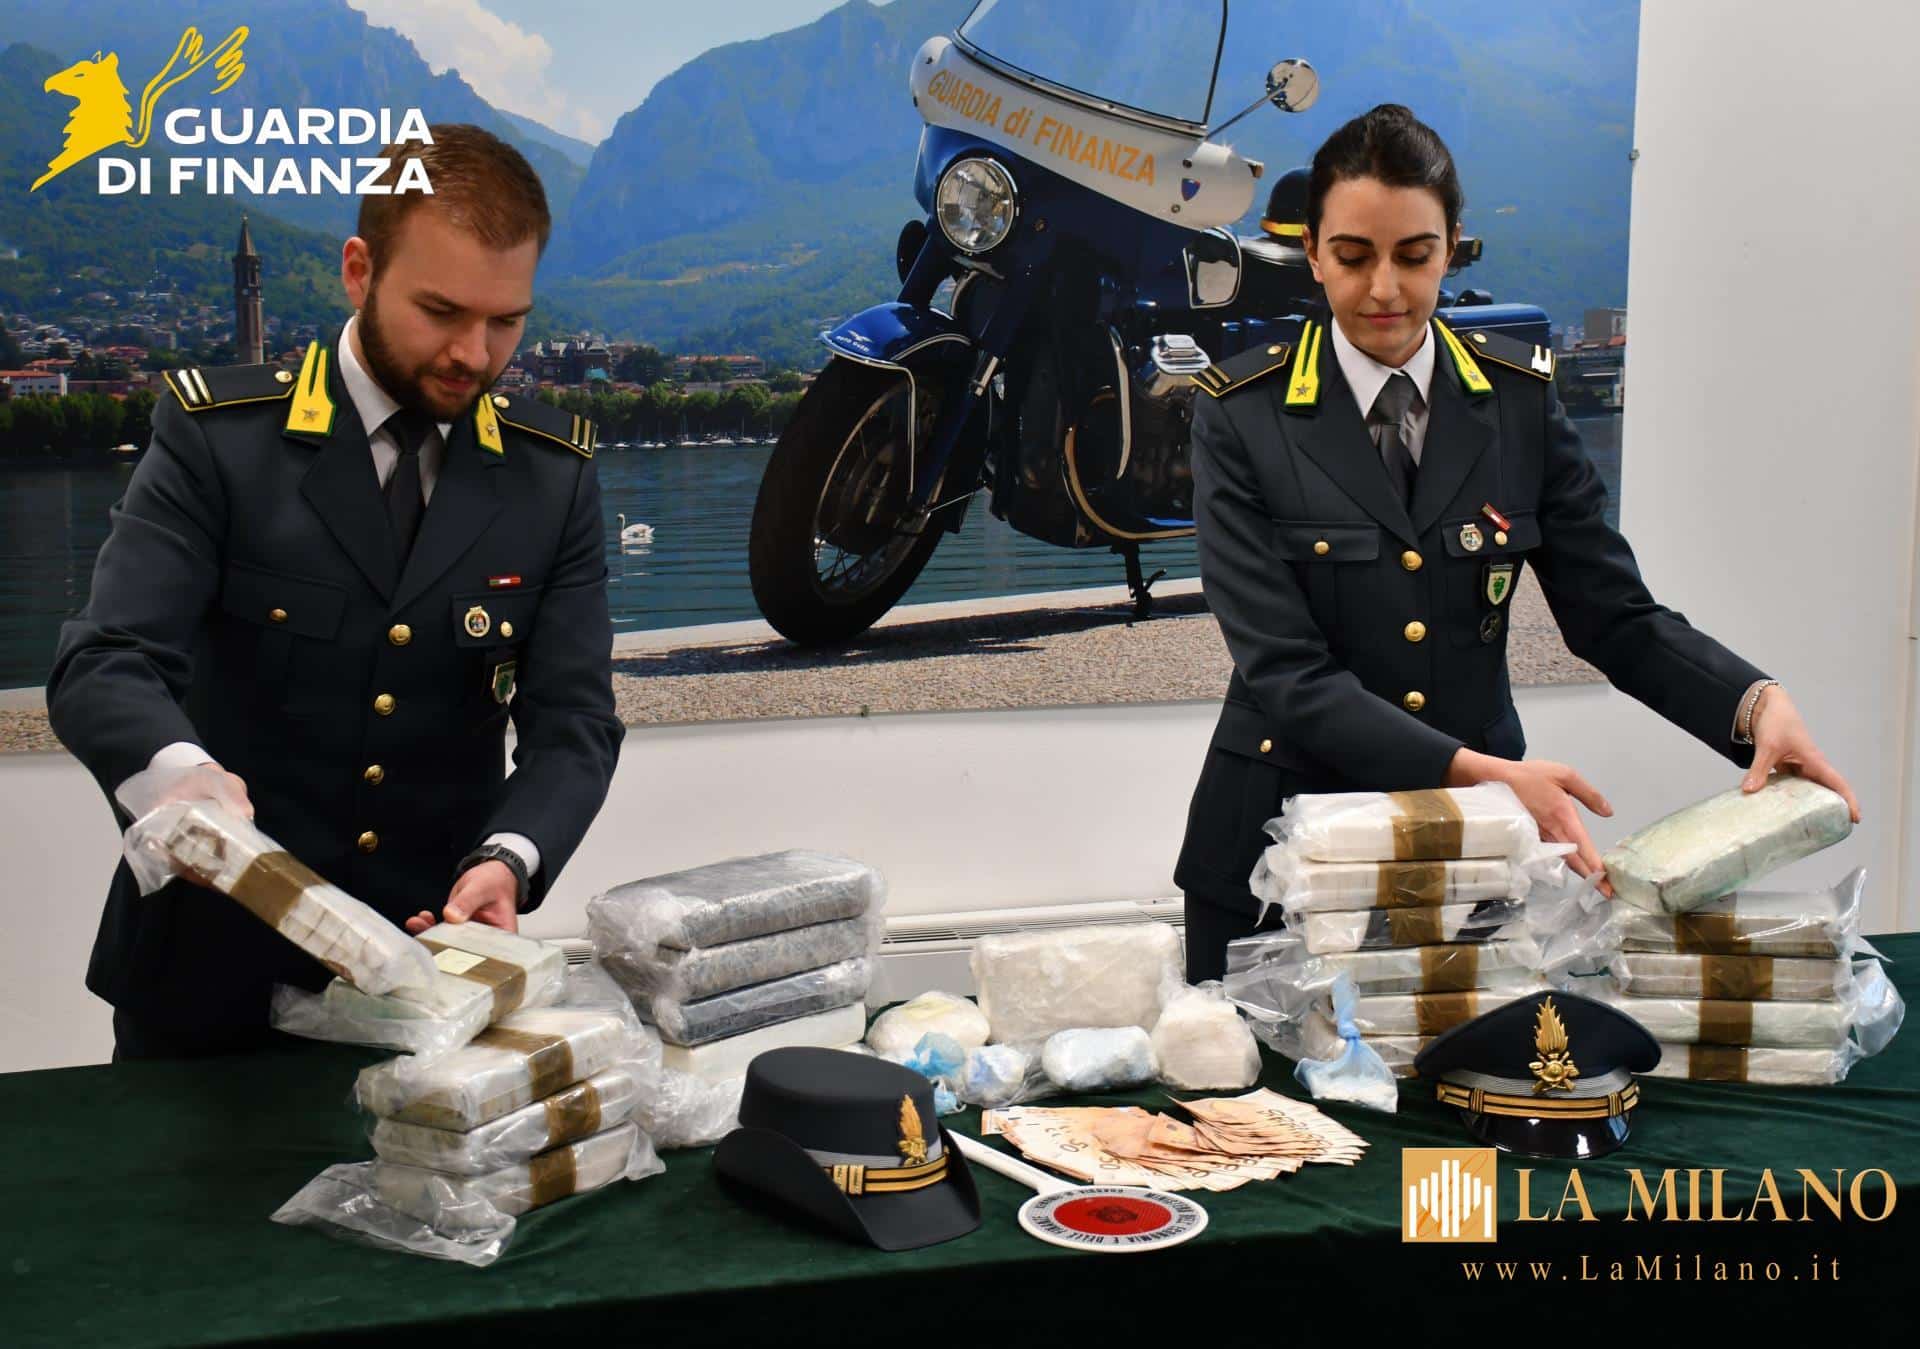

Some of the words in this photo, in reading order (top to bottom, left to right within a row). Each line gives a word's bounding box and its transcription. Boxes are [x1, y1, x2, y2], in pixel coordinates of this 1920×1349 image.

[926, 68, 1001, 126] GUARDIA
[1003, 106, 1031, 138] di
[1033, 114, 1157, 186] FINANZA
